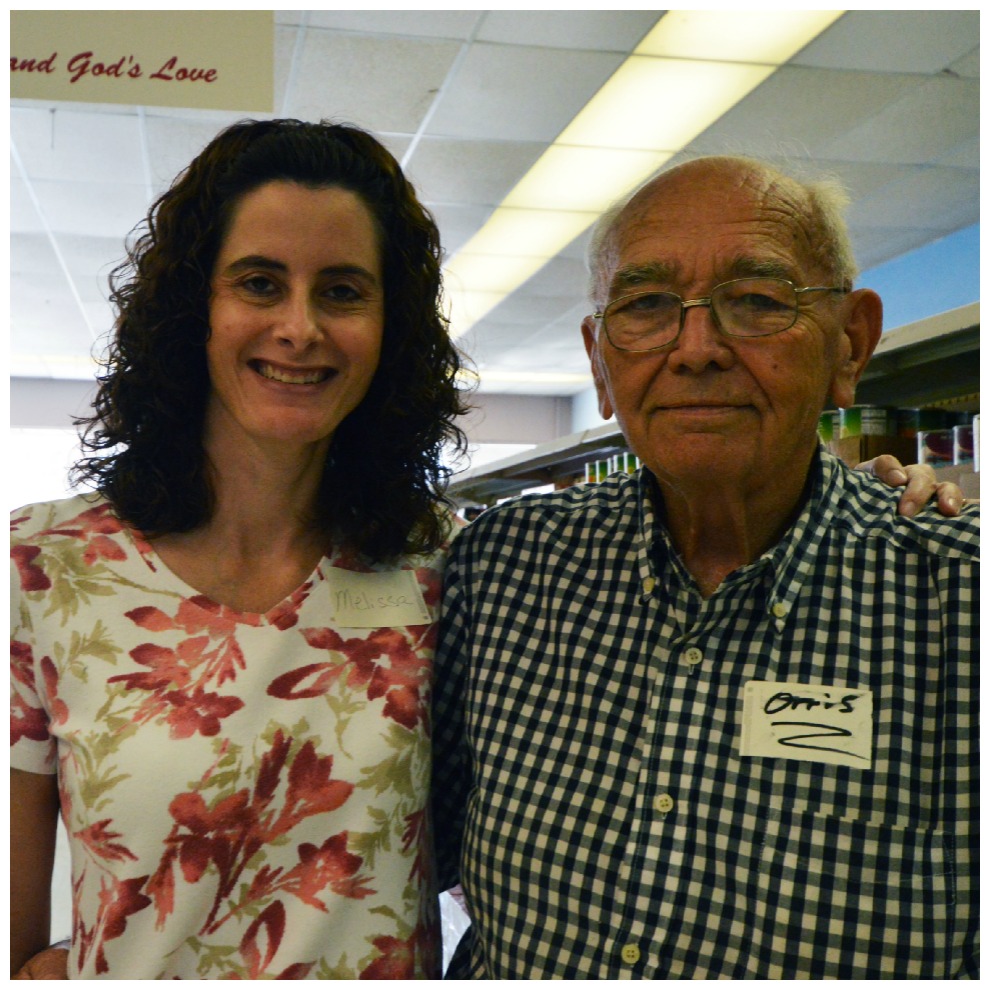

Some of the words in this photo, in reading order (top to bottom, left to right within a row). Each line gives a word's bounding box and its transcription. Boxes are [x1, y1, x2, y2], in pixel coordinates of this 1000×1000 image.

[66, 51, 143, 84] God's
[149, 56, 218, 83] Love
[335, 588, 414, 612] Melissa
